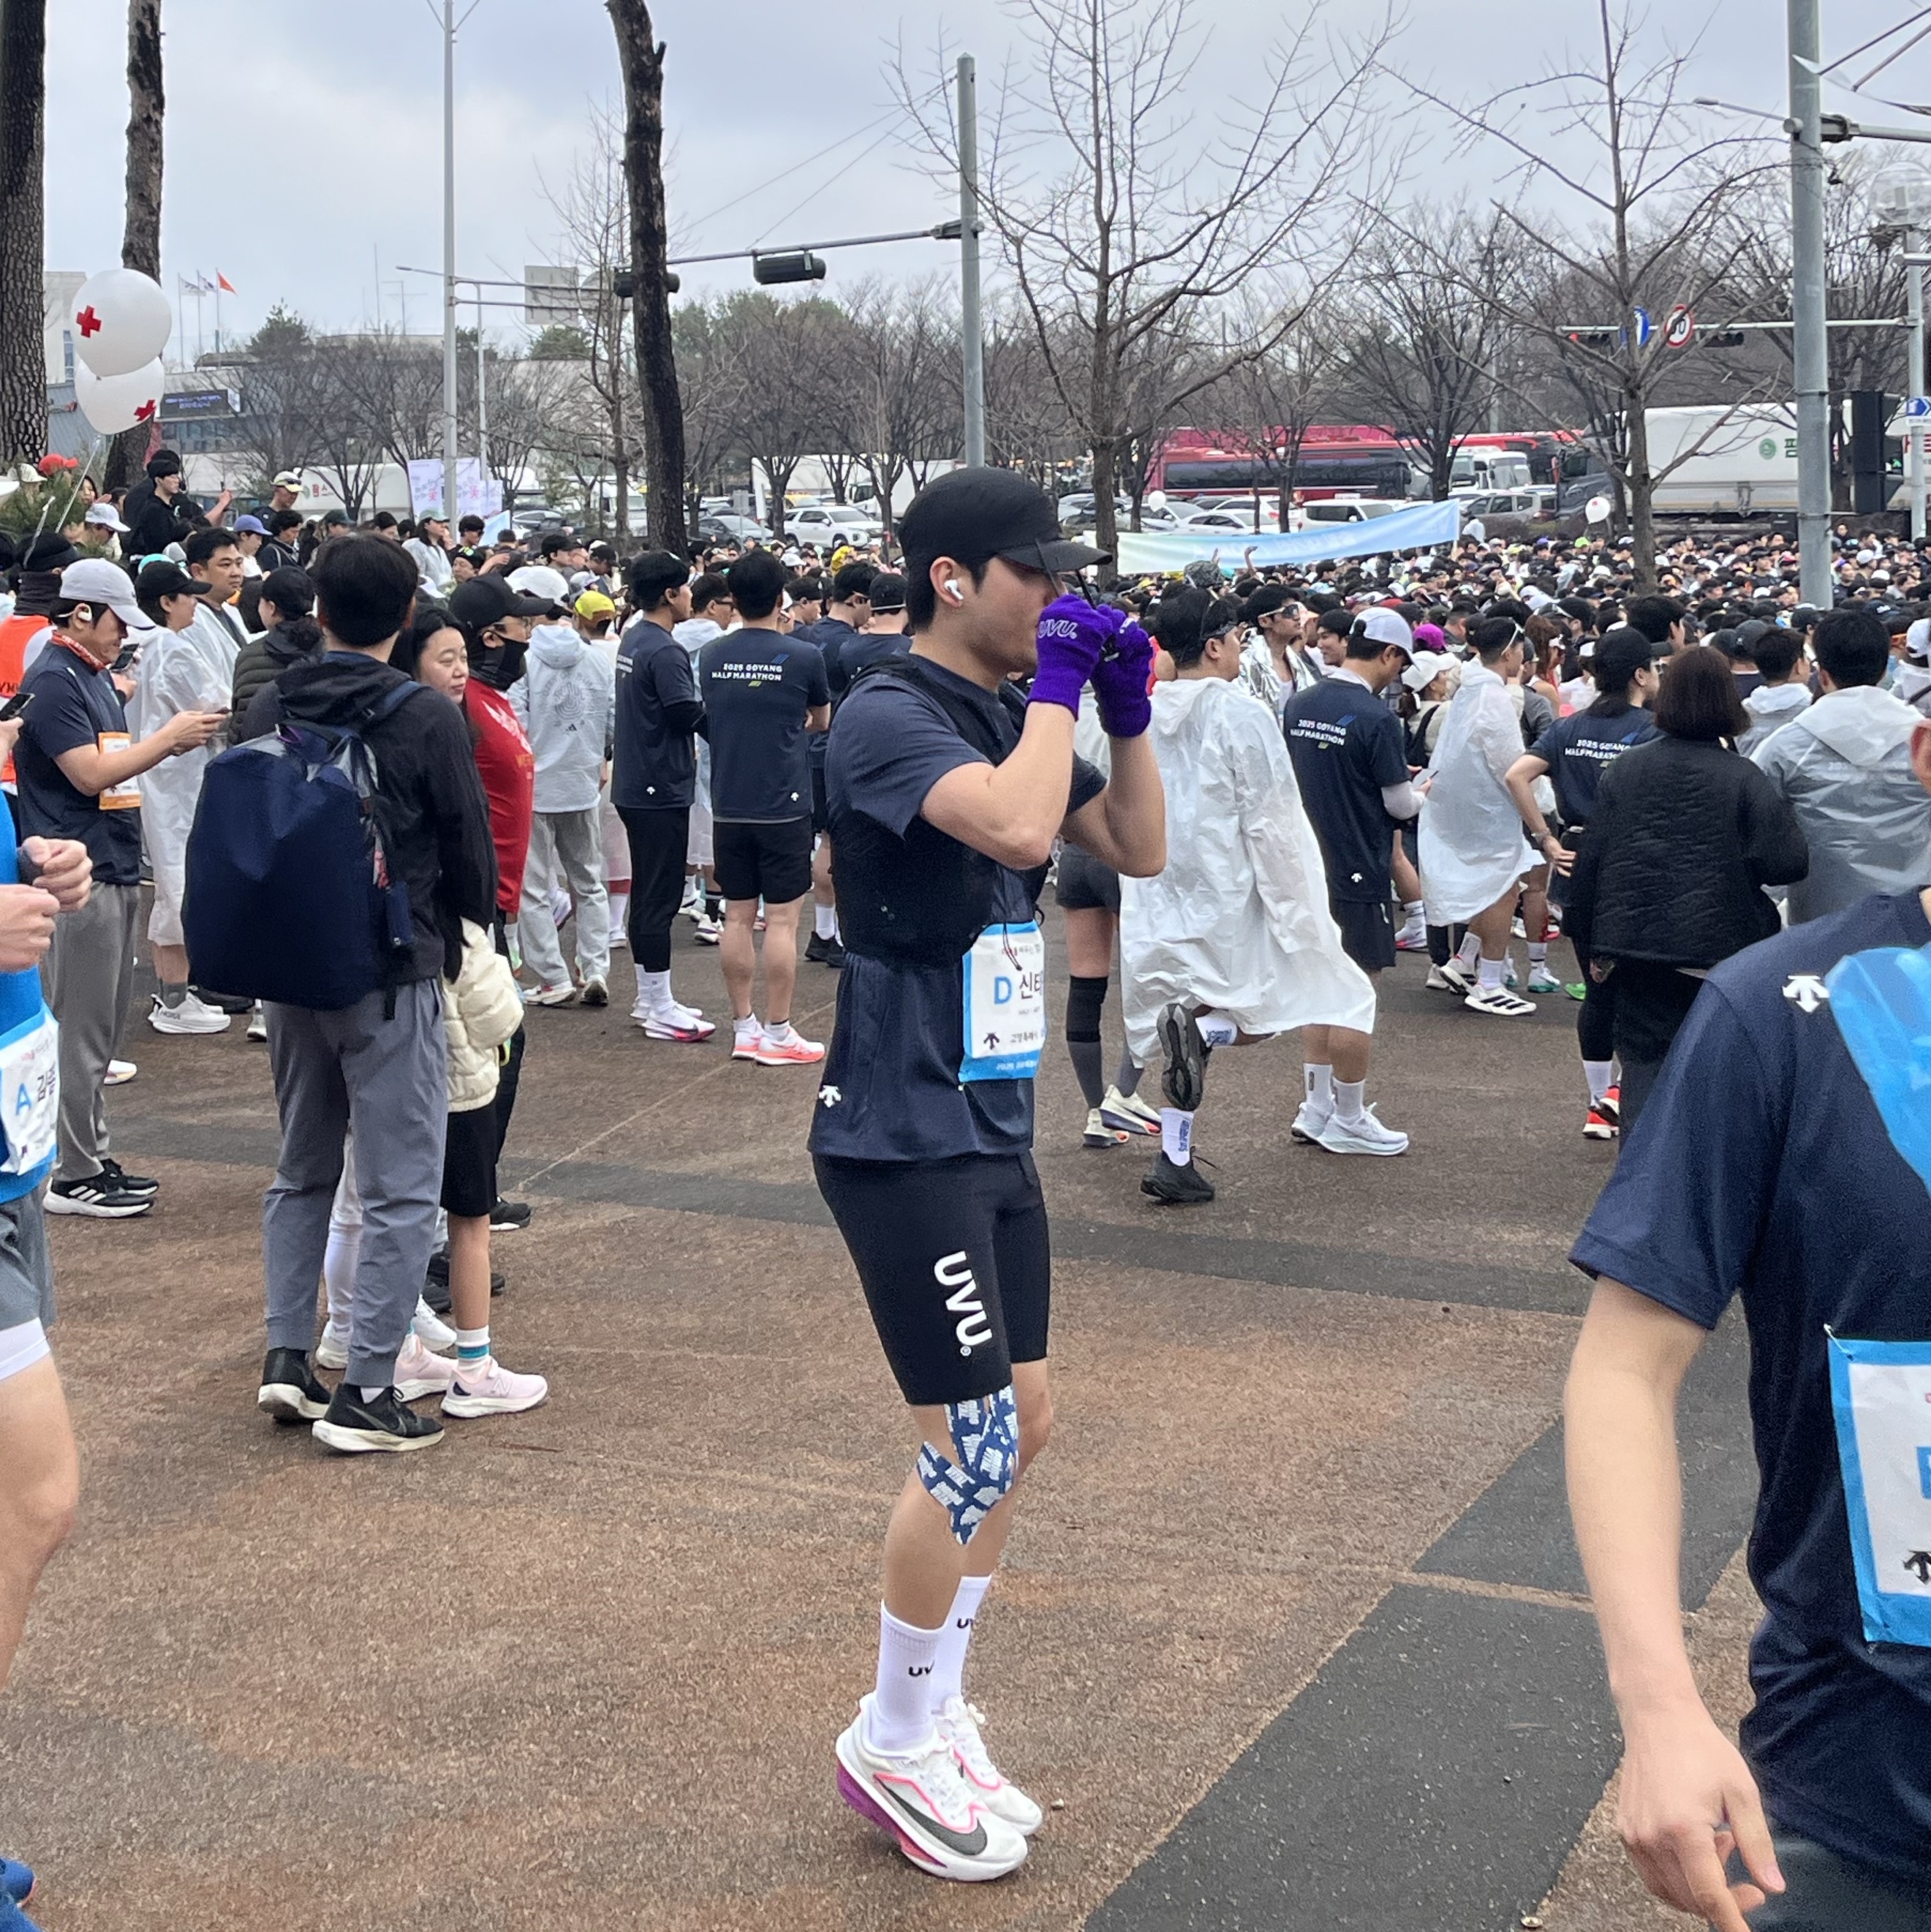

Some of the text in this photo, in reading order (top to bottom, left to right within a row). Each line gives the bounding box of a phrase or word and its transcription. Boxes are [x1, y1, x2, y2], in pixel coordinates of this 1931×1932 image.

[723, 663, 783, 673] 2025 GOYANG
[711, 671, 782, 682] HALF MARATHON
[1297, 719, 1346, 736] 2025 GOYANG
[1576, 739, 1598, 750] 2025
[994, 976, 1013, 1005] D
[15, 1082, 32, 1117] A
